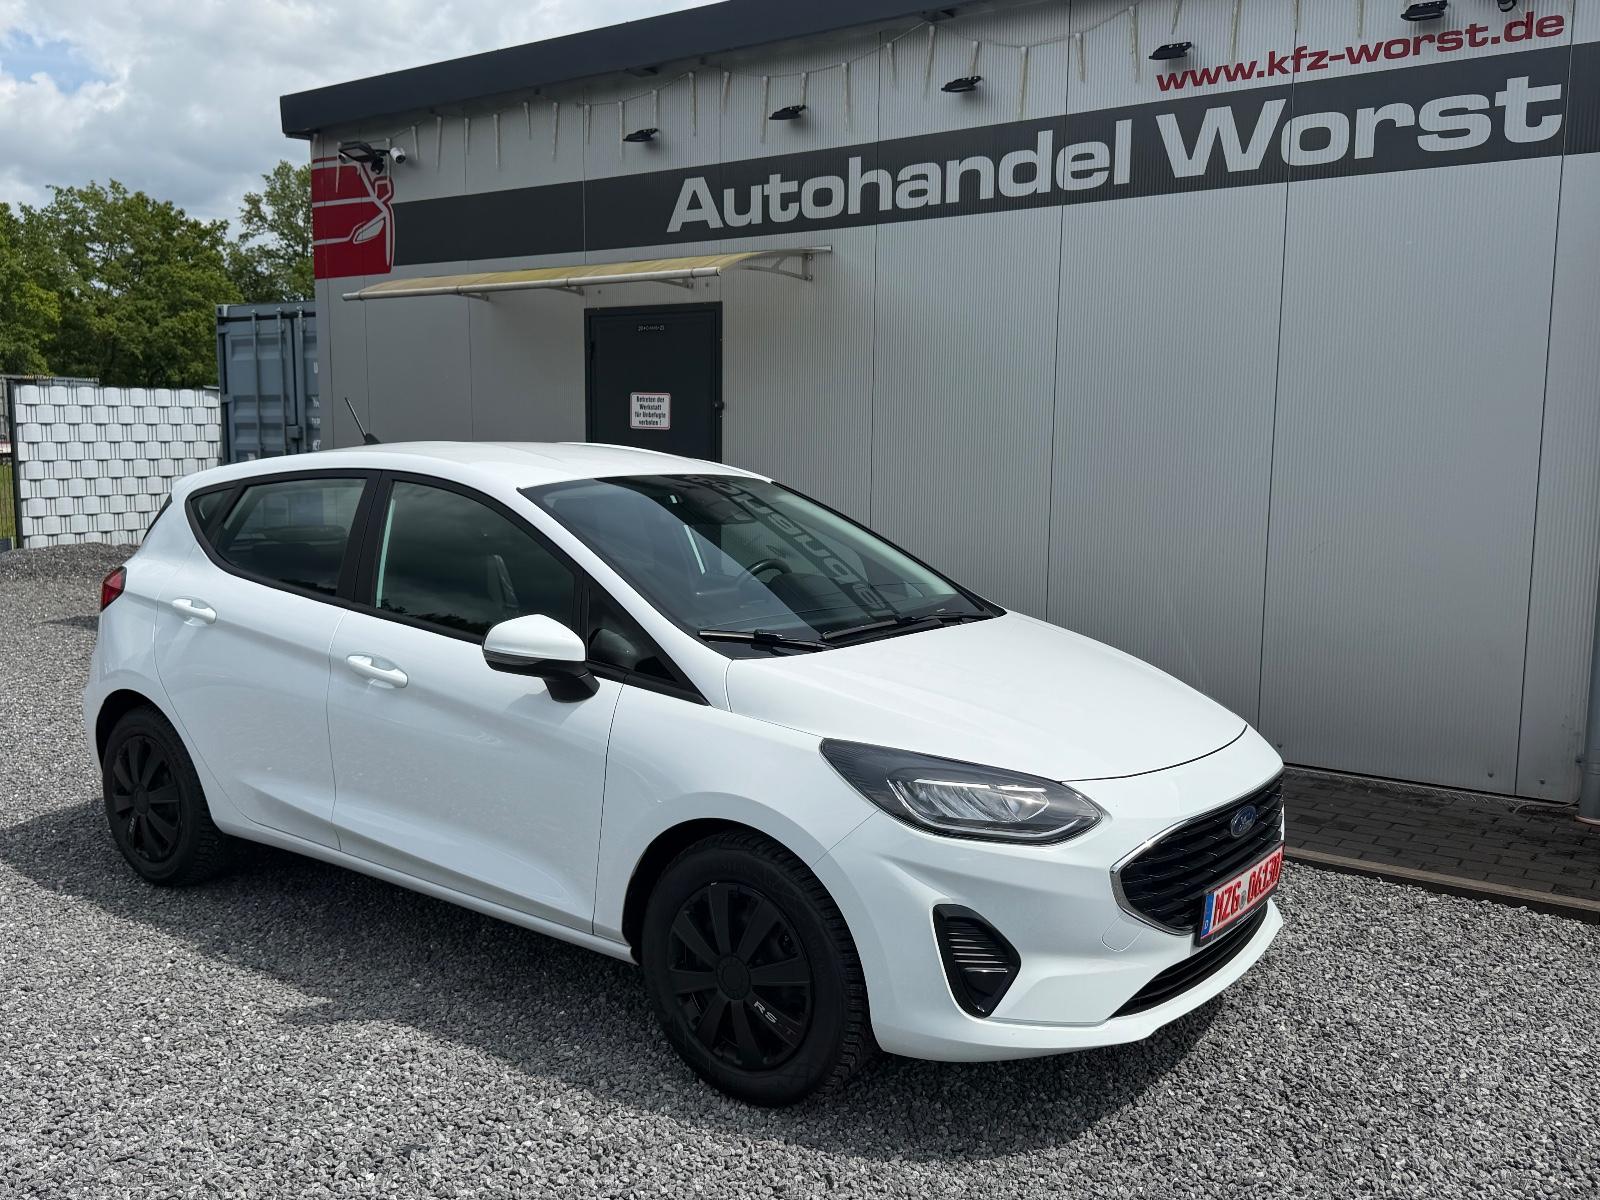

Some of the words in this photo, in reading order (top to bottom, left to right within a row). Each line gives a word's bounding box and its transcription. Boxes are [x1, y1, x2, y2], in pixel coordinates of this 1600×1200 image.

[1156, 11, 1566, 92] www.kfz-worst.de
[666, 119, 1133, 233] Autohandel
[1155, 76, 1563, 178] Worst
[639, 403, 662, 411] Werkstatt
[1212, 880, 1241, 927] MZG
[753, 1000, 777, 1023] RS
